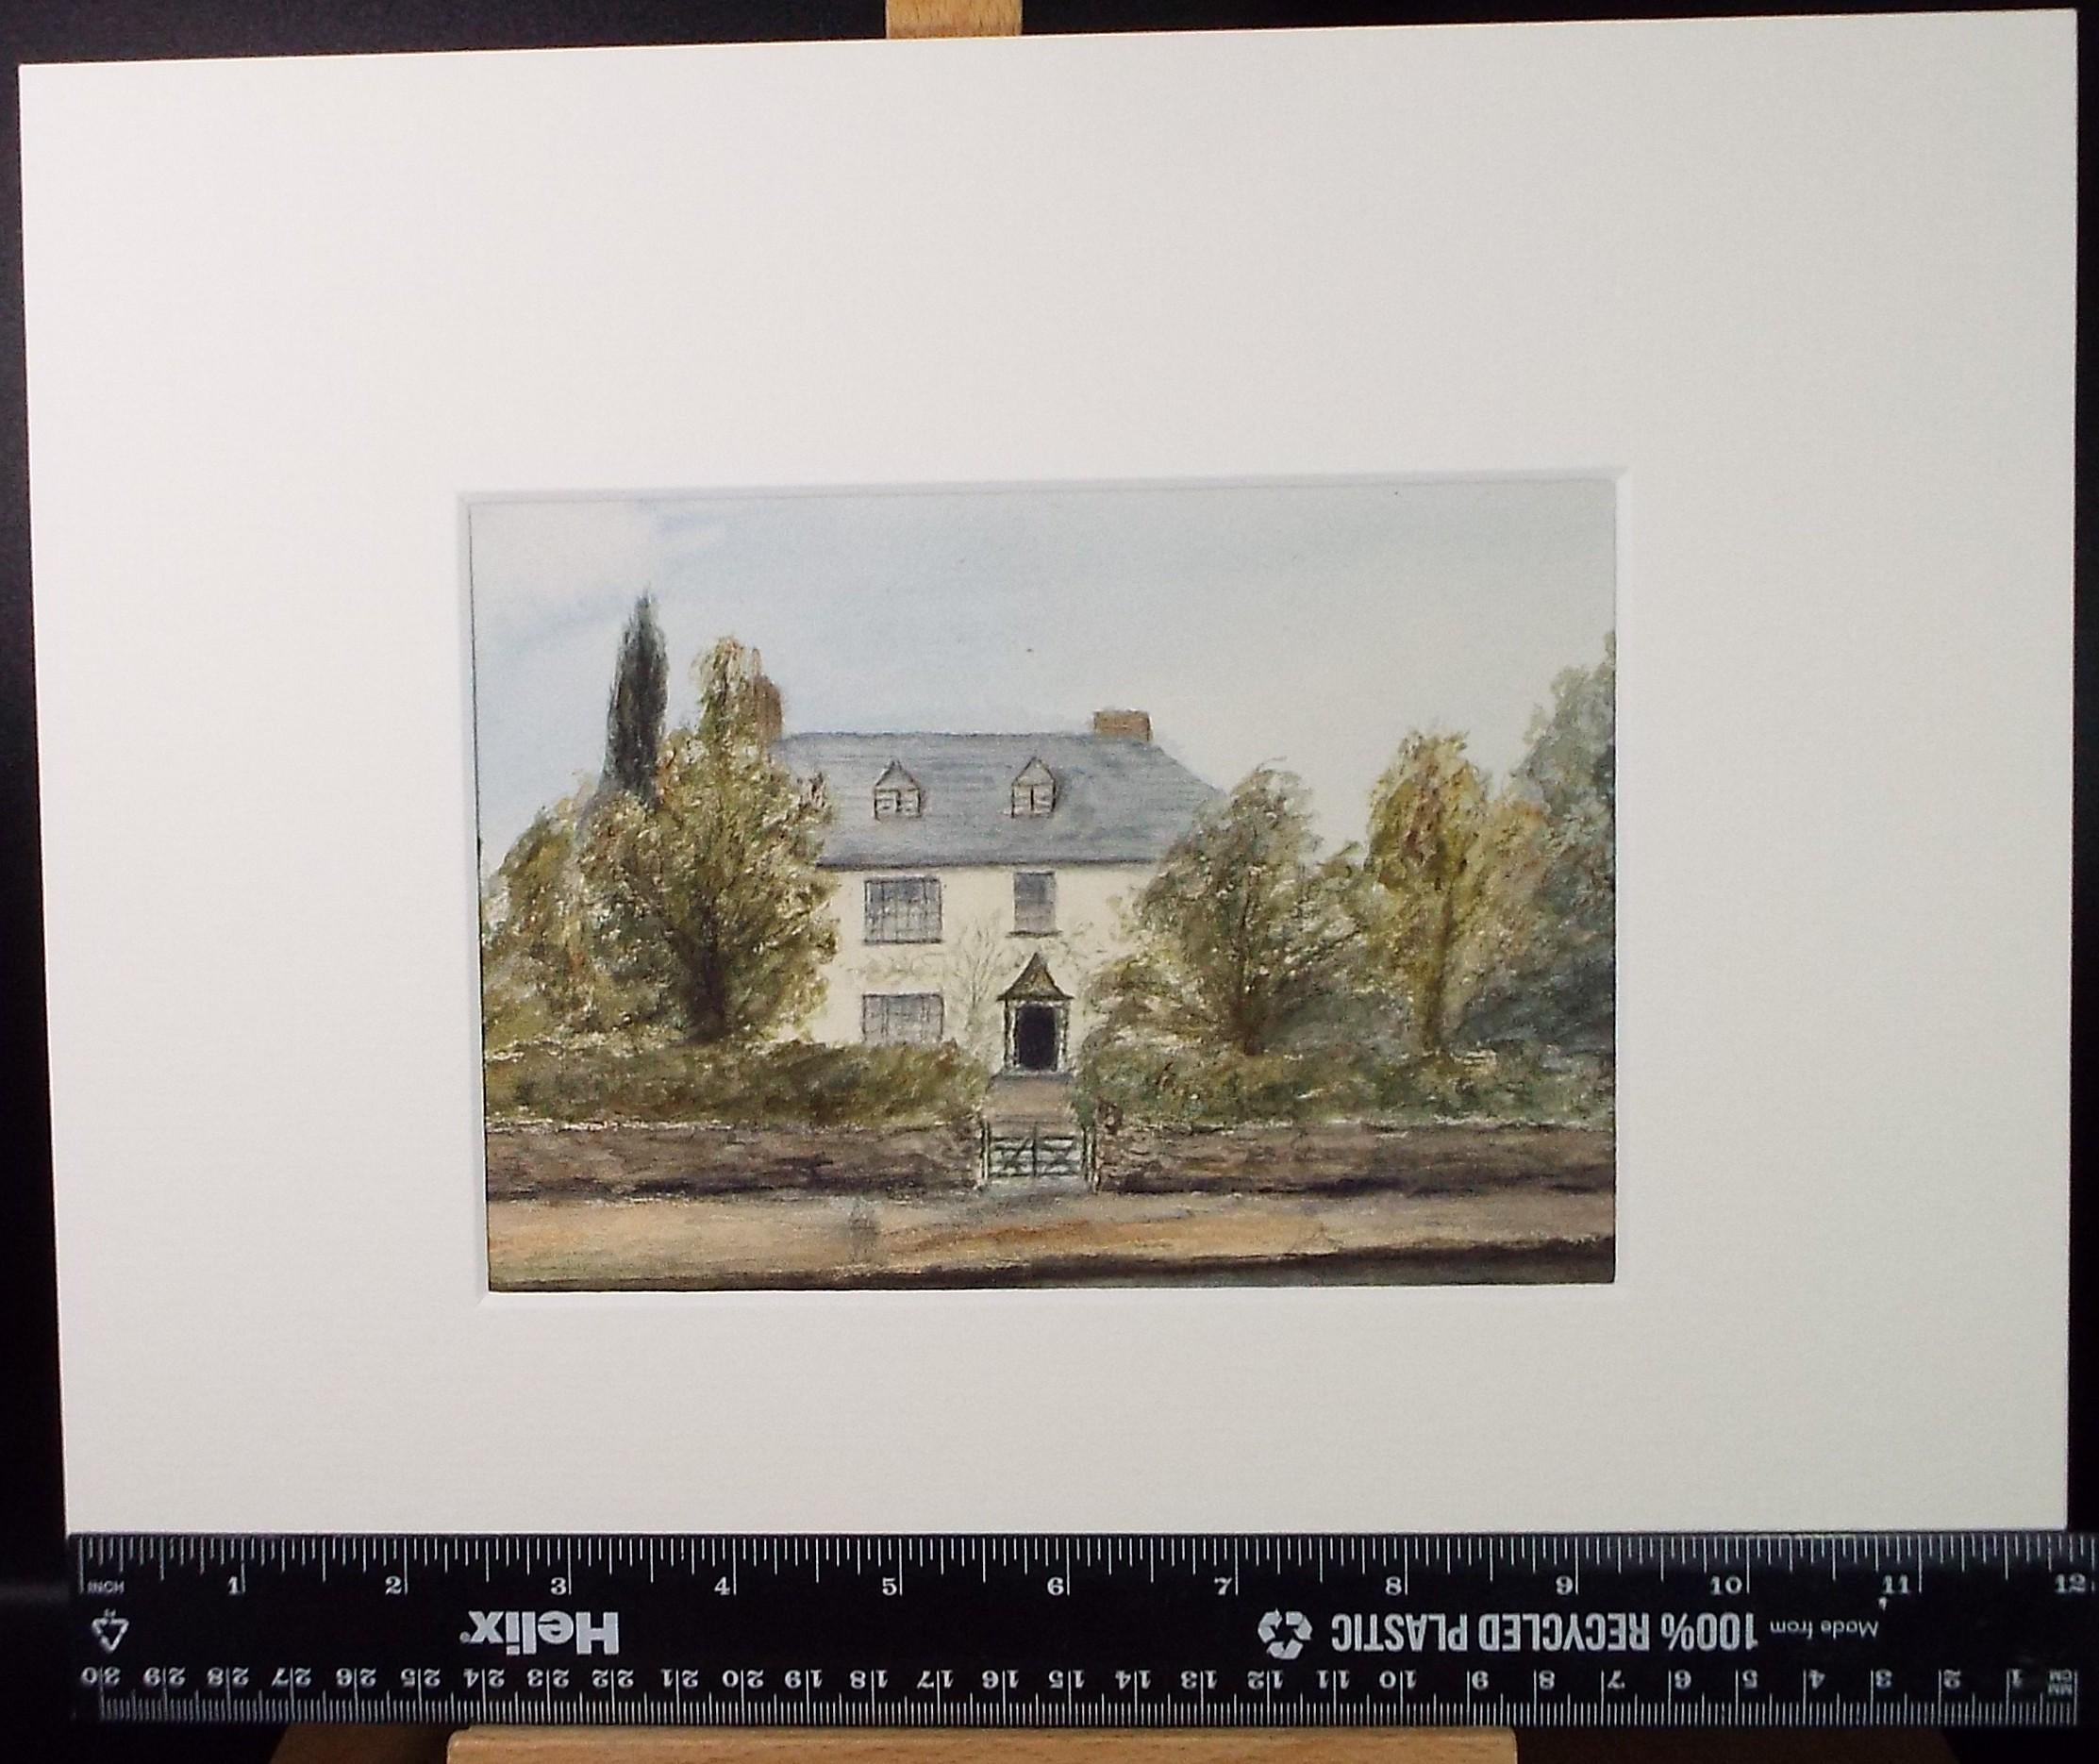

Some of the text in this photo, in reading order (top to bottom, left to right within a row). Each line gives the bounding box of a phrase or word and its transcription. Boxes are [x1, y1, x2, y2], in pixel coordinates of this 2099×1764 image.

[87, 1580, 125, 1594] INCH
[227, 1573, 2086, 1595] 1 2 3 4 5 6 7 8 9 10 11 12
[468, 1610, 620, 1656] Helix
[1331, 1611, 1879, 1652] Made from 100% RECYCLED PLASTIC
[82, 1668, 2024, 1689] 1 2 3 4 5 6 7 8 9 10 11 12 13 14 15 16 17 18 19 20 21 22 23 24 25 26 27 28 29 30
[2049, 1670, 2073, 1682] CM
[2048, 1683, 2074, 1695] MM
